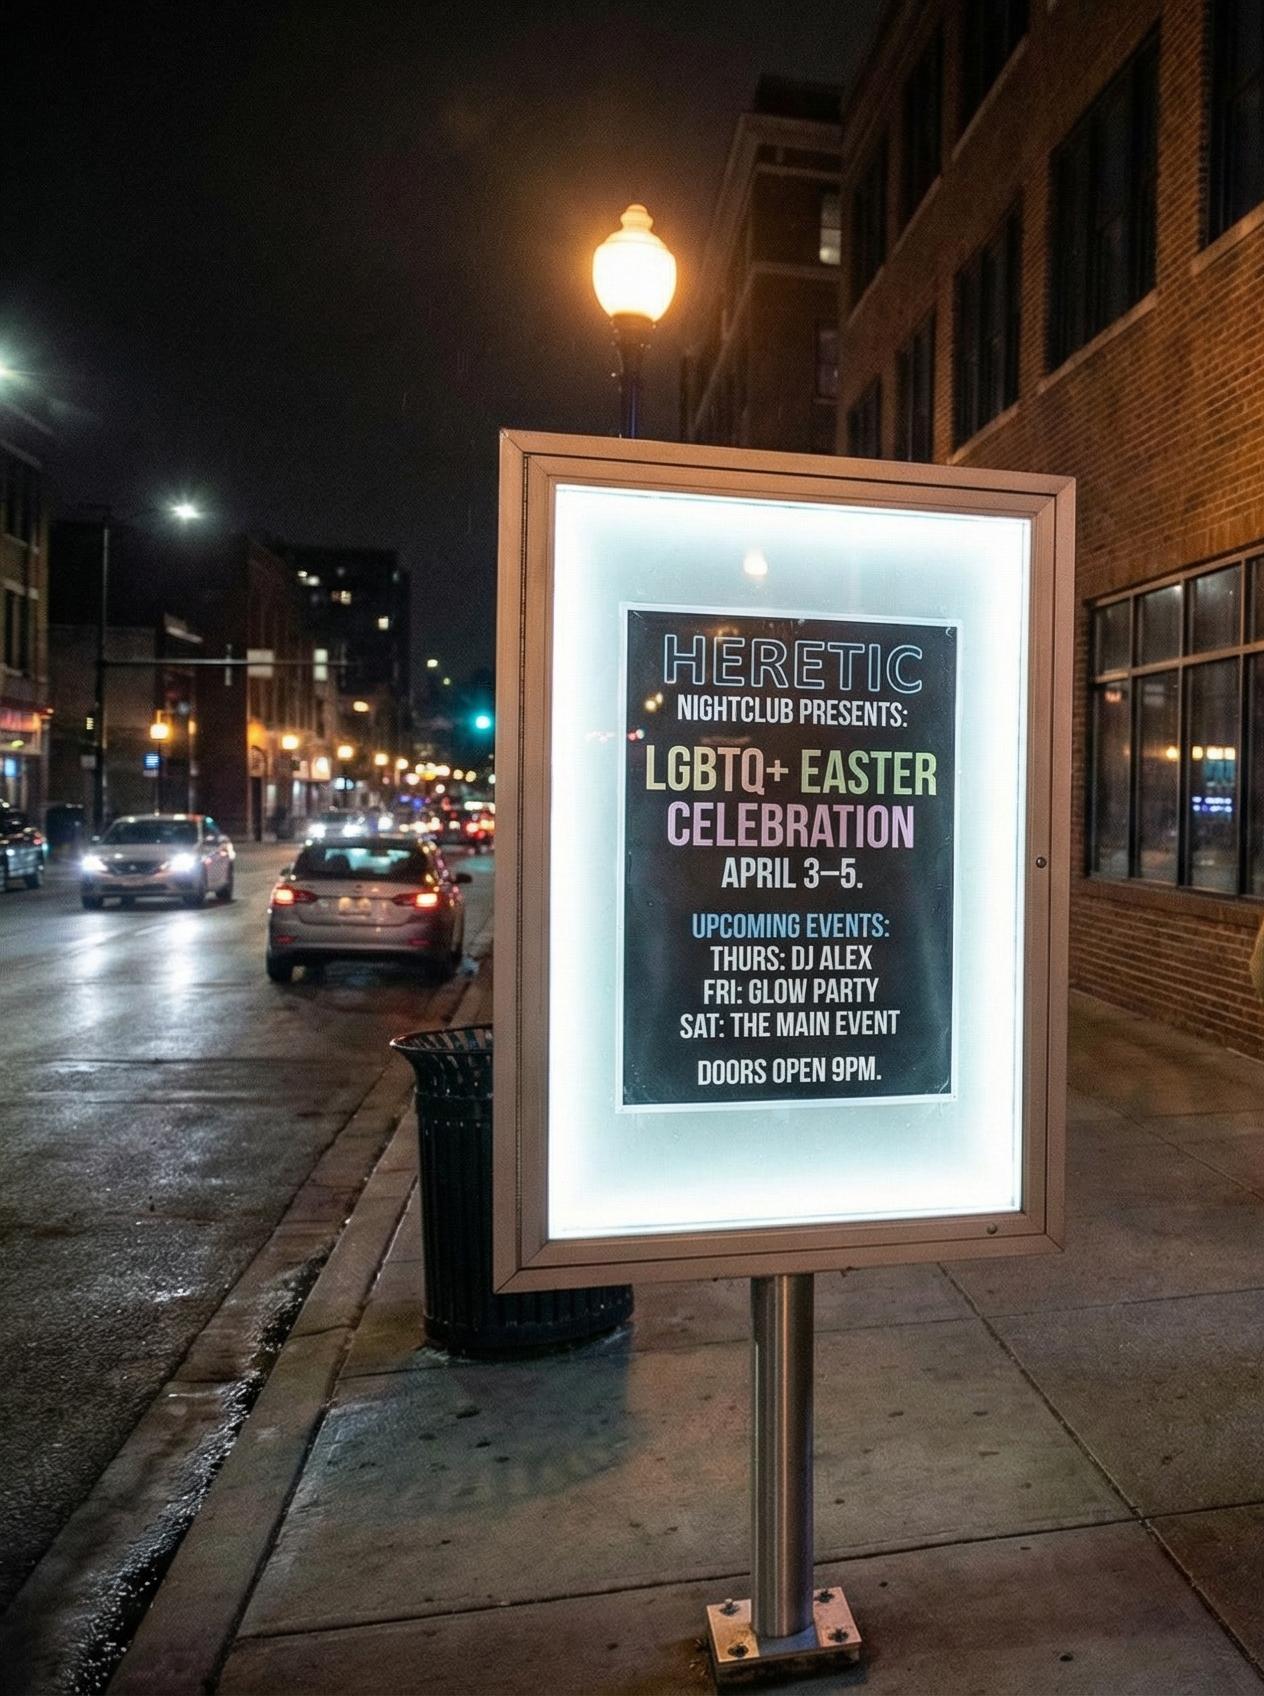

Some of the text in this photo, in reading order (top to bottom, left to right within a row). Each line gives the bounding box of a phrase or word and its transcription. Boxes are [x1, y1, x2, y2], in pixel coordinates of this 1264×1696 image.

[663, 633, 923, 694] HERETIC
[677, 694, 909, 728] NIGHTCLUB PRESENTS:
[645, 744, 937, 796] LGBTQ+ EASTER
[667, 801, 915, 848] CELEBRATION
[721, 857, 797, 888] APRIL
[692, 913, 890, 939] UPCOMING EVENTS:
[710, 945, 873, 971] THURS: DJ ALEX
[703, 978, 880, 1005] FRI: GLOW PARTY
[680, 1009, 901, 1039] SAT: THE MAIN EVENT
[697, 1055, 882, 1086] DOORS OPEN 9PM.
